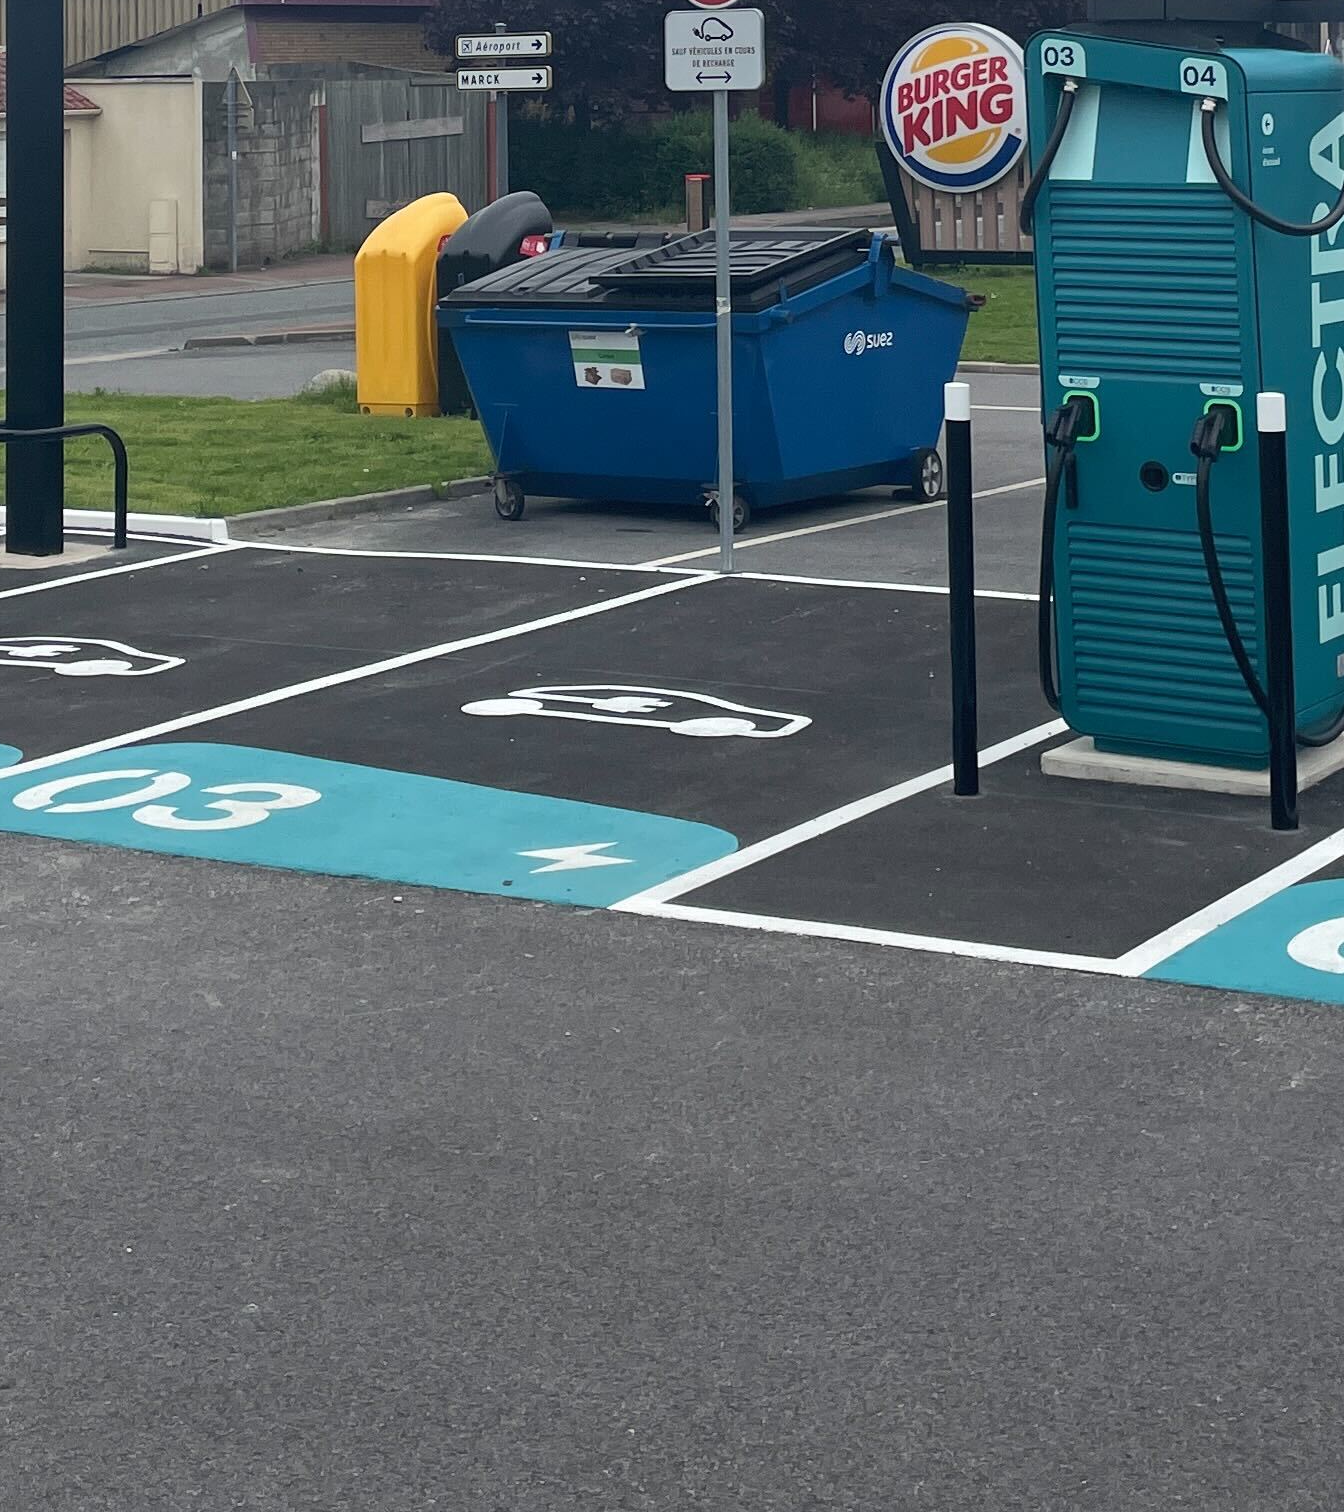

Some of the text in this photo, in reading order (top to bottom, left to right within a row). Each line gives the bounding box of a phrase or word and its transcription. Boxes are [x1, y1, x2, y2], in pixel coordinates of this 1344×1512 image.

[476, 41, 521, 53] Aéroport
[671, 47, 687, 56] SAUF
[724, 46, 733, 55] EN
[734, 46, 756, 55] COURS
[692, 59, 735, 68] DE RECHARGE
[1044, 47, 1074, 67] 03
[461, 74, 500, 85] MARCK
[1183, 65, 1216, 87] 04
[897, 56, 1009, 115] BURGER
[903, 83, 1014, 155] KING
[866, 332, 893, 349] suez
[12, 769, 322, 831] 03
